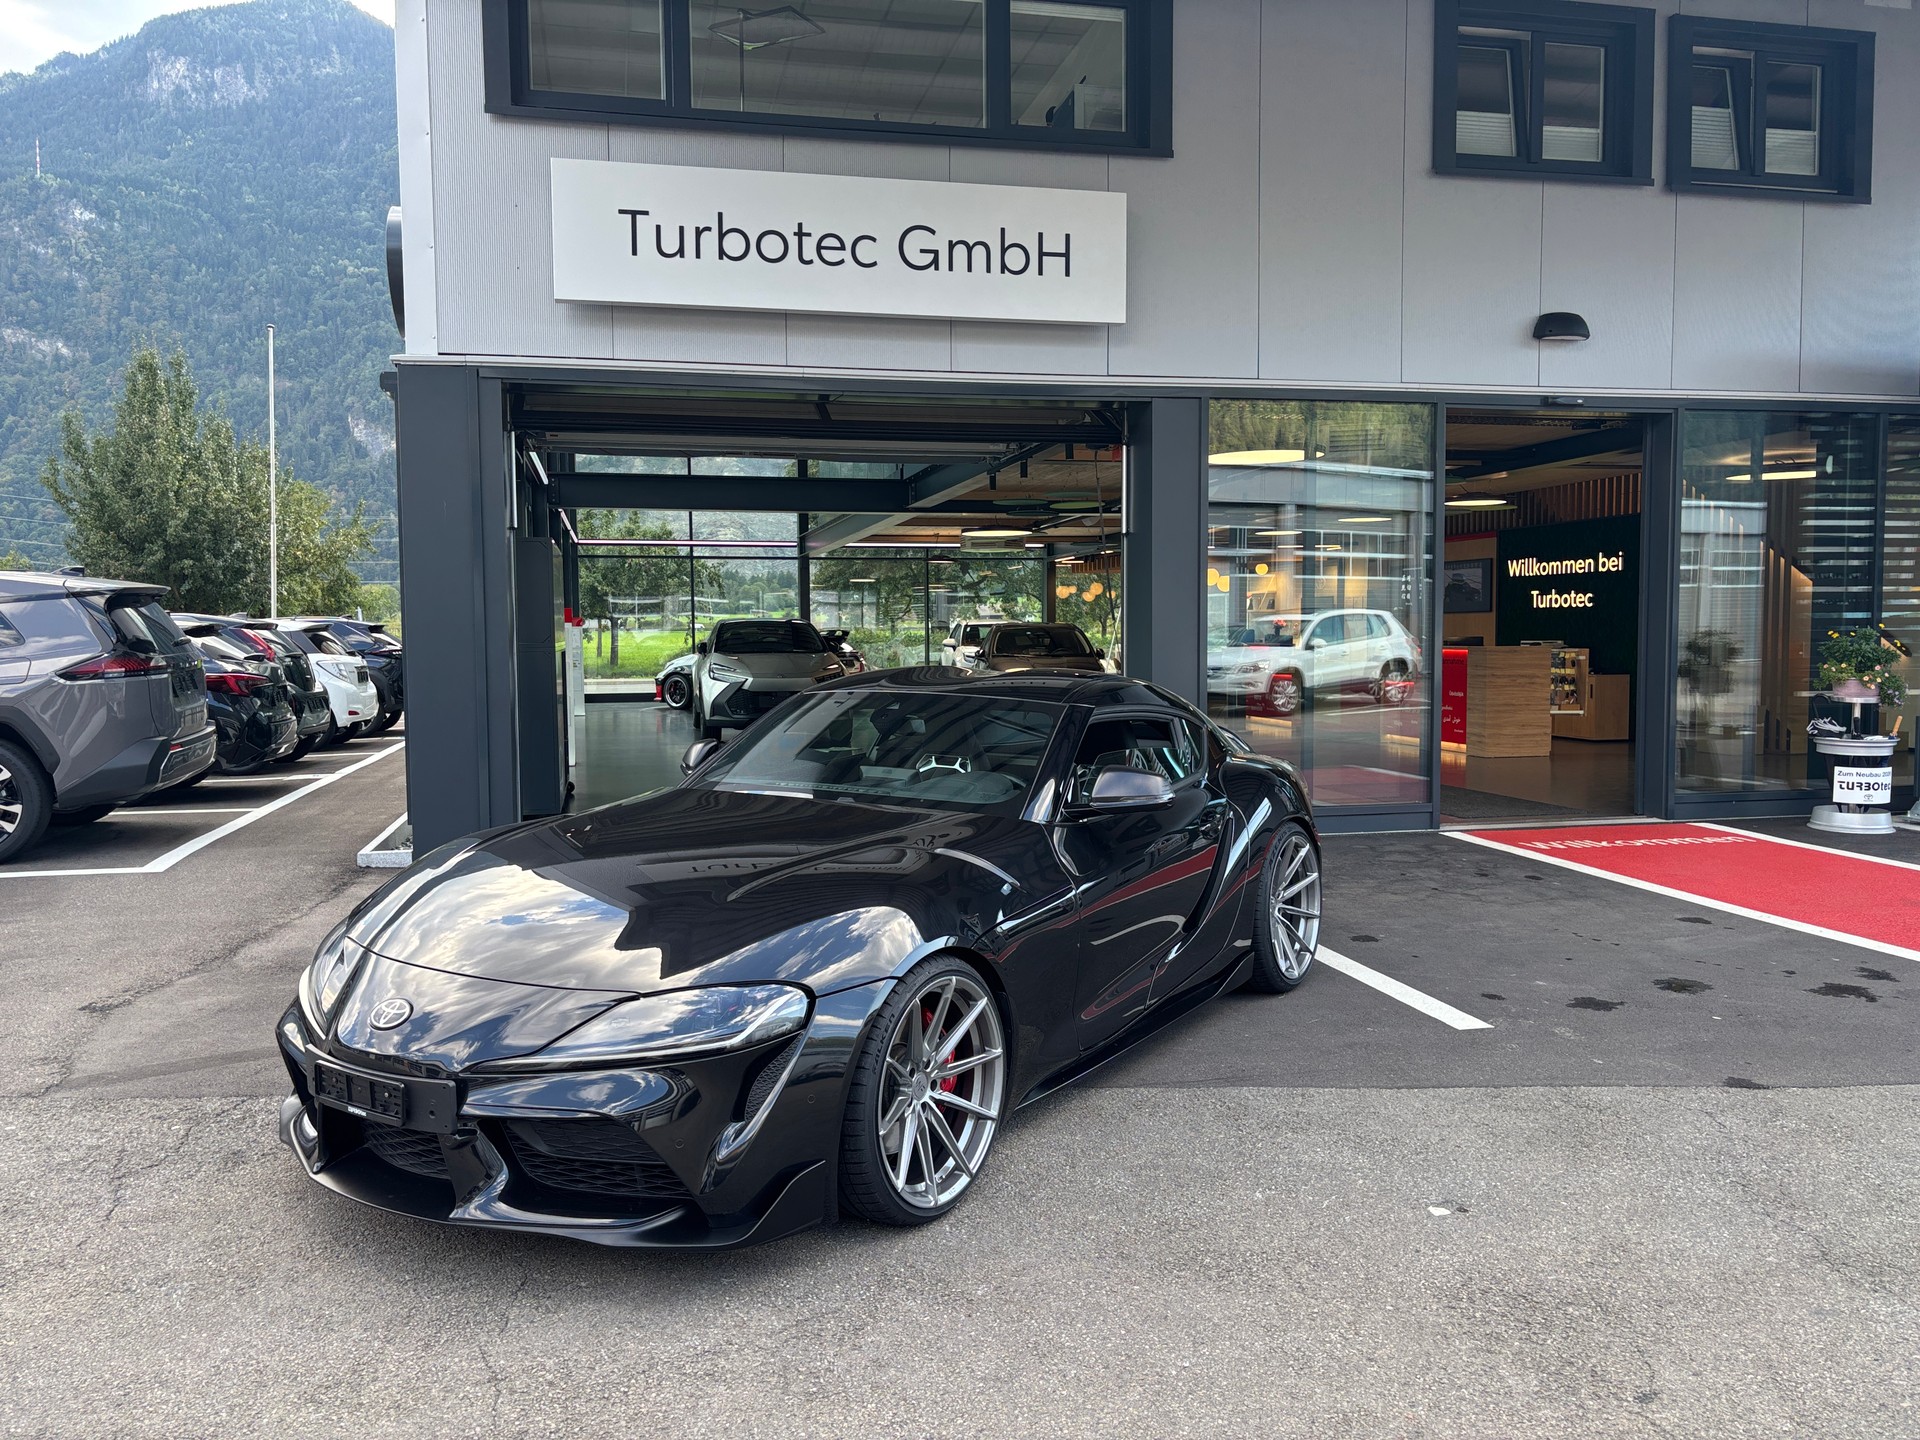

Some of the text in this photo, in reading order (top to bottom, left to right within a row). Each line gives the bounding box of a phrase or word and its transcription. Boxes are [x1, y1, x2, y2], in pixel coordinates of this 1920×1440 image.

[618, 209, 1071, 277] Turbotec GmbH
[1507, 551, 1623, 577] Willkommen bei
[1530, 588, 1594, 609] Turbotec
[1518, 836, 1757, 850] Willkommen
